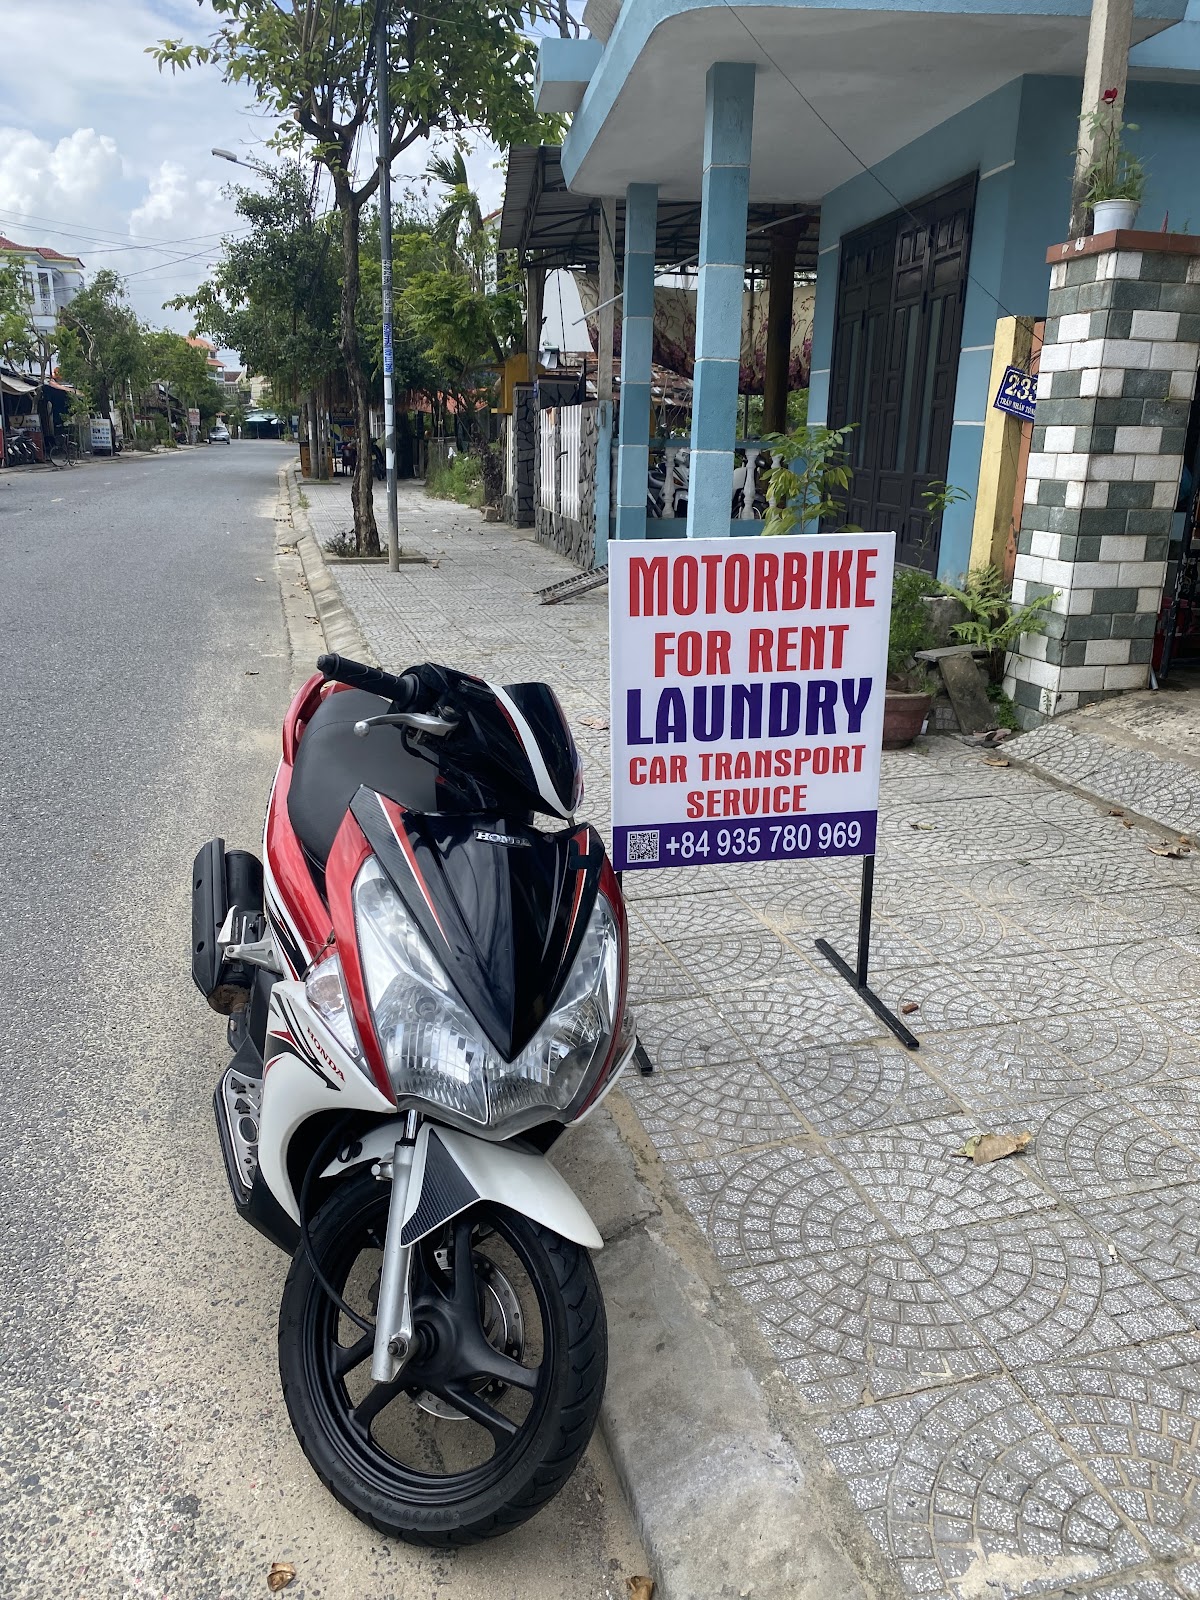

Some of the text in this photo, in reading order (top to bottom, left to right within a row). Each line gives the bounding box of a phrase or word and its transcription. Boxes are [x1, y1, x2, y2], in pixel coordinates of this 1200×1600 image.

[628, 548, 879, 617] MOTORBIKE
[654, 624, 850, 678] FOR RENT
[626, 677, 873, 746] LAUNDRY
[628, 744, 867, 786] CAR TRANSPORT
[686, 784, 808, 819] SERVICE
[475, 831, 532, 847] HONDA
[665, 820, 862, 860] +84 935 780 969
[307, 1026, 346, 1082] HONDA
